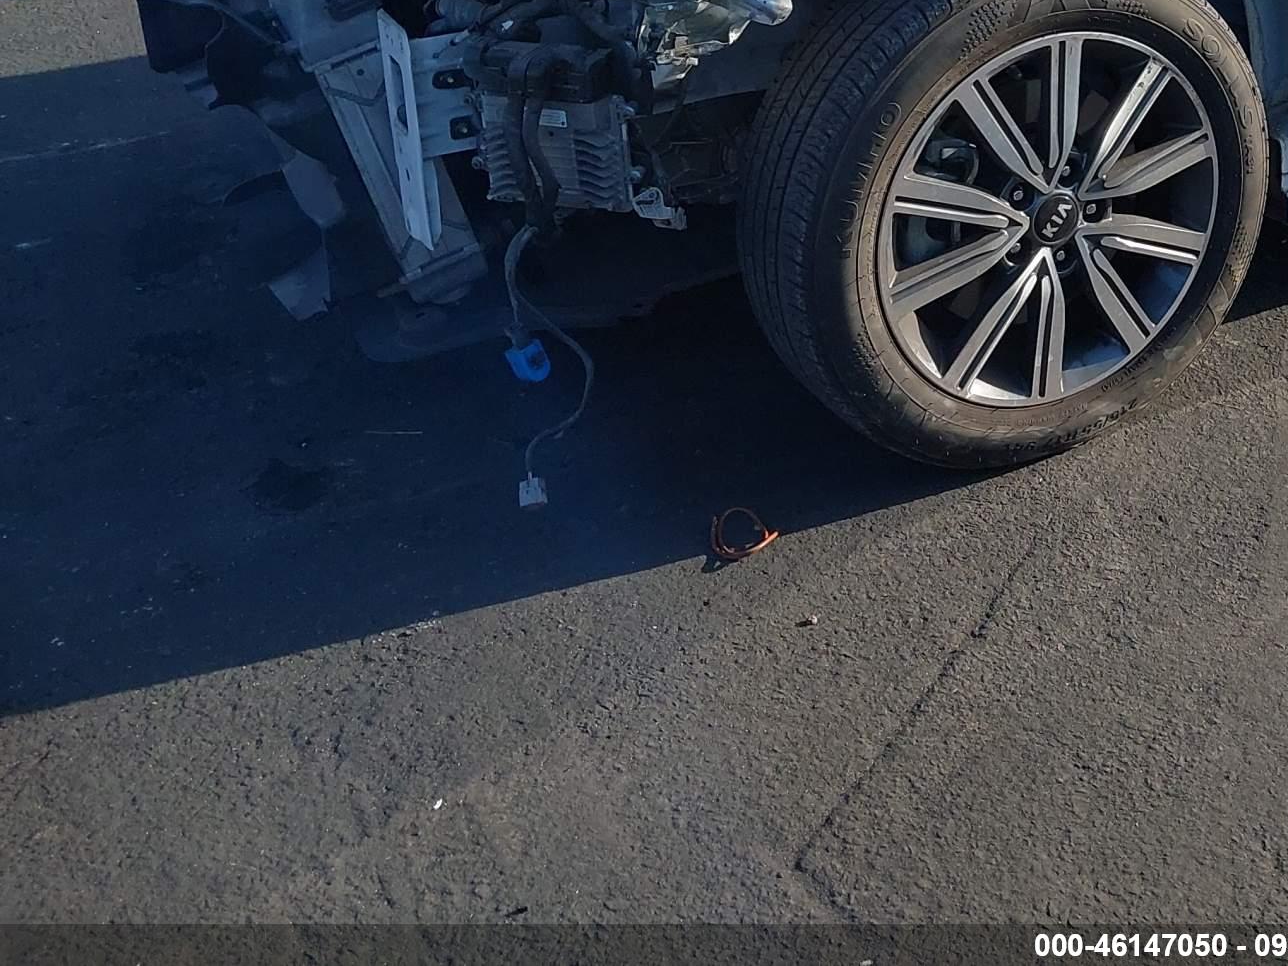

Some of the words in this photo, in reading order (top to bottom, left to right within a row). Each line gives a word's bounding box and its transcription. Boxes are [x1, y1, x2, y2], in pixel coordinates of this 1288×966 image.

[1182, 16, 1254, 130] SOLUS
[835, 101, 903, 260] KUMHO
[1041, 202, 1073, 239] KIA
